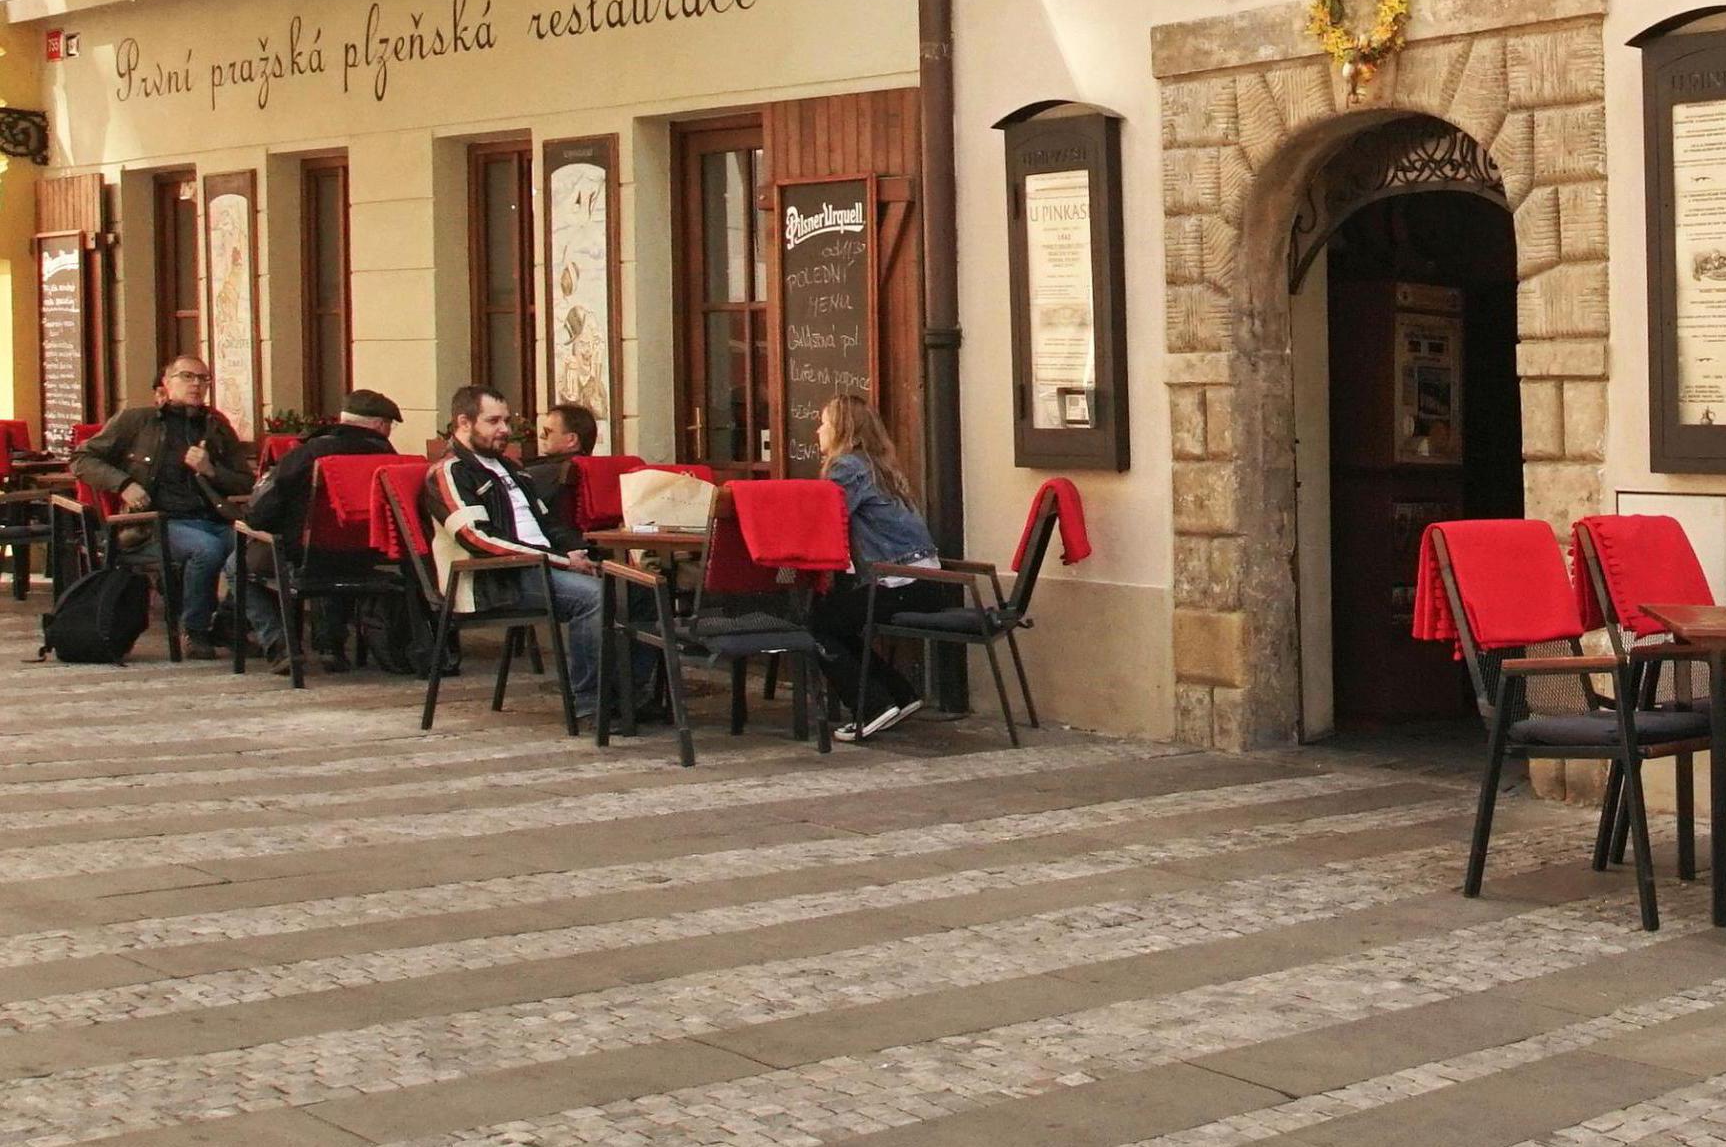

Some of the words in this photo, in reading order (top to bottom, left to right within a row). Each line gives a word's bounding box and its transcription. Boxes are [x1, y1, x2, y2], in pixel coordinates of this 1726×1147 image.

[116, 37, 193, 102] První
[211, 16, 325, 110] pražská
[786, 206, 825, 250] Pilsner
[822, 202, 863, 234] Urquell
[1030, 206, 1039, 222] U
